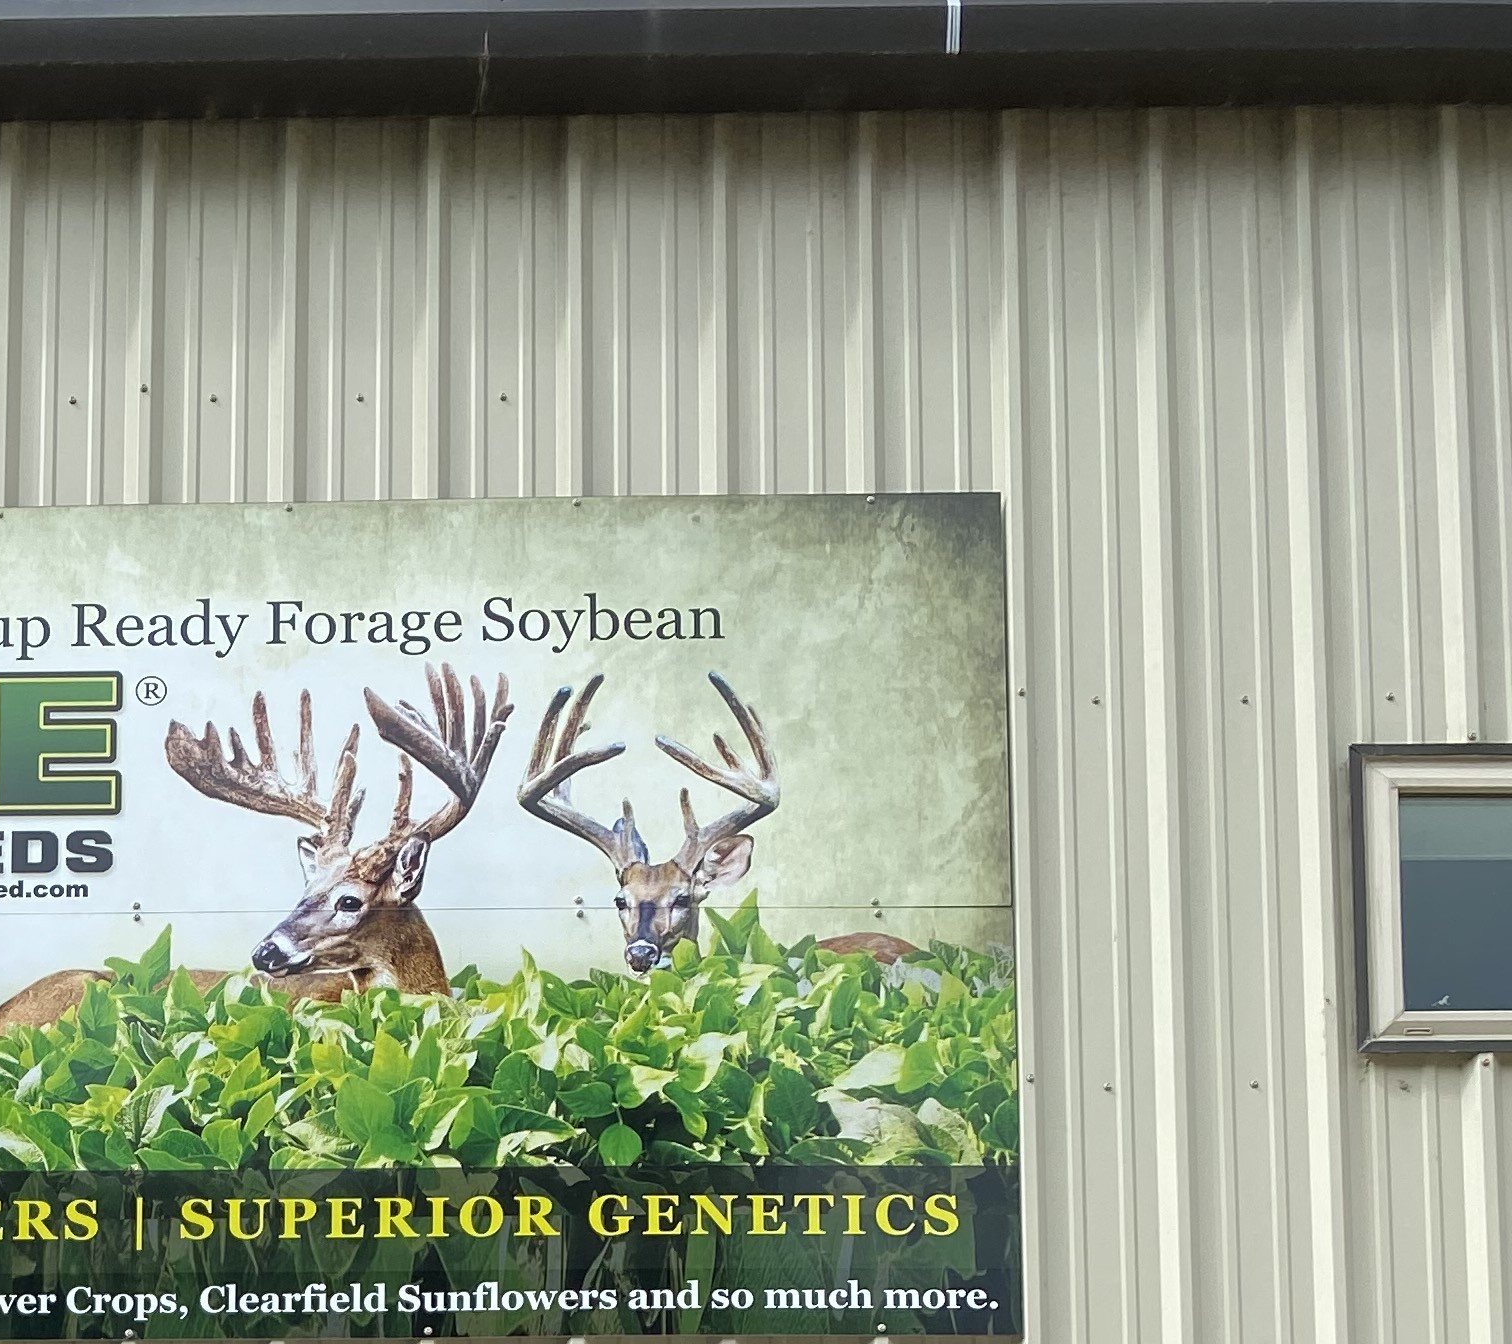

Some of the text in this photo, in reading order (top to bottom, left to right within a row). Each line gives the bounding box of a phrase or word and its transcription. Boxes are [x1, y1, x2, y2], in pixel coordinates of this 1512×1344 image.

[71, 599, 249, 658] Ready
[265, 600, 463, 655] Forage
[482, 593, 726, 658] Soybean
[179, 1195, 561, 1241] SUPERIOR
[589, 1192, 962, 1237] GENETICS
[66, 1286, 188, 1323] Crops,
[199, 1283, 389, 1314] Clearfield
[397, 1281, 618, 1313] Sunflowers
[628, 1280, 702, 1311] and
[711, 1287, 754, 1311] so
[763, 1280, 874, 1310] much
[883, 1287, 999, 1311] more.
